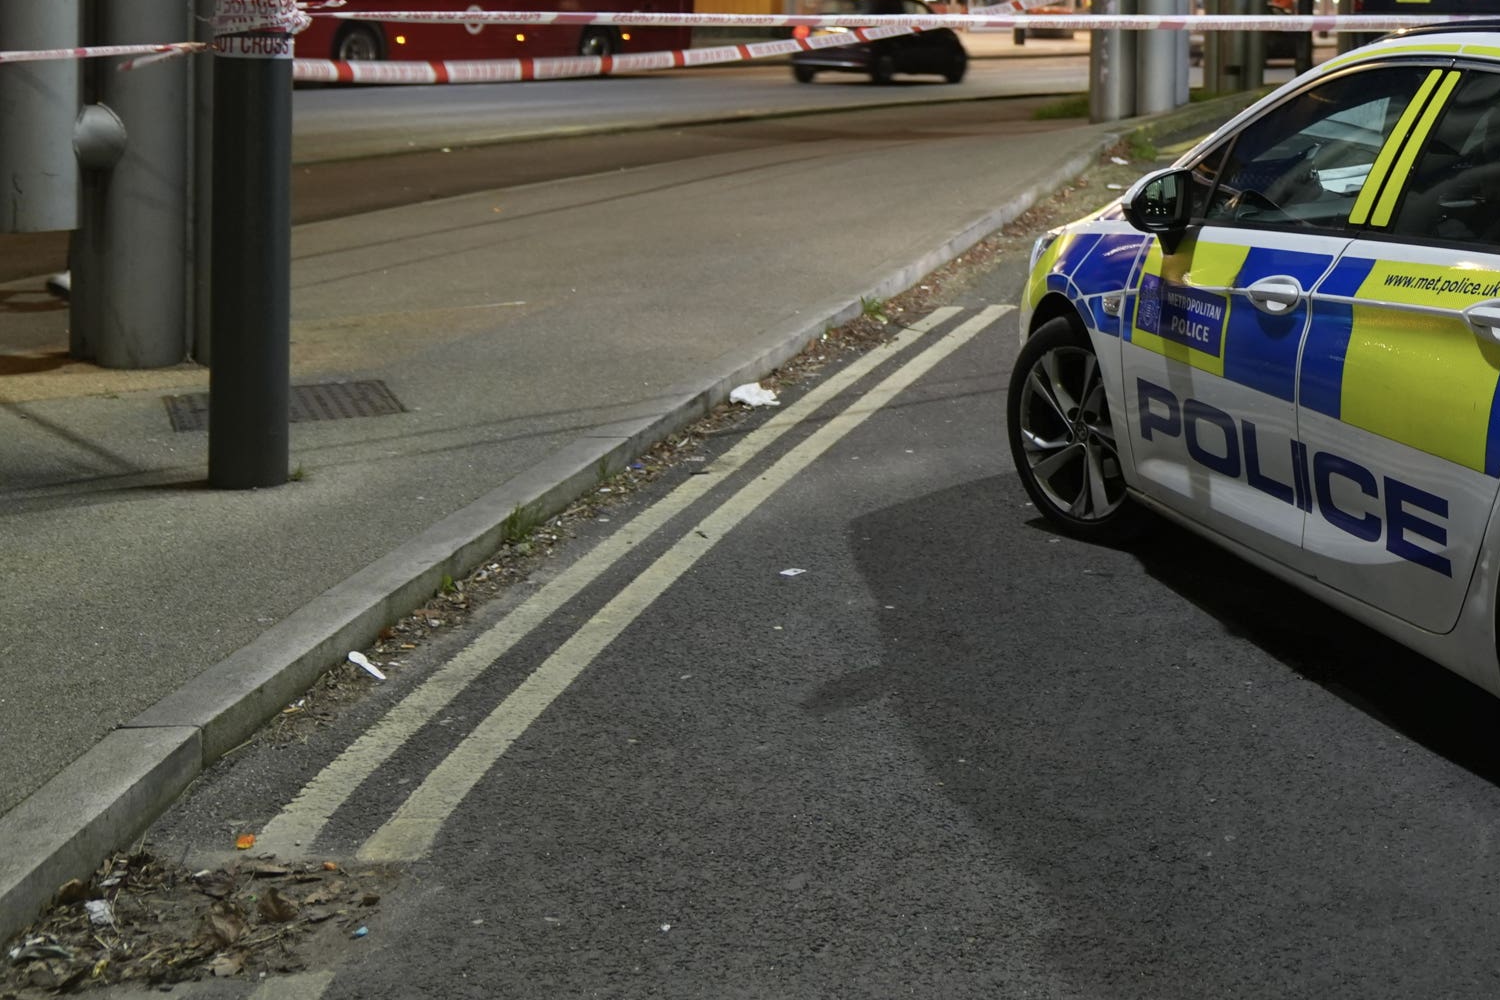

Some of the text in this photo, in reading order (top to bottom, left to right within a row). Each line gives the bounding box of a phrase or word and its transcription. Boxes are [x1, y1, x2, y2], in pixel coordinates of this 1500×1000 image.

[240, 36, 289, 54] CROSS
[1167, 291, 1222, 321] METROPOLITAN
[1171, 315, 1210, 343] POLICE
[1137, 377, 1452, 578] POLICE
